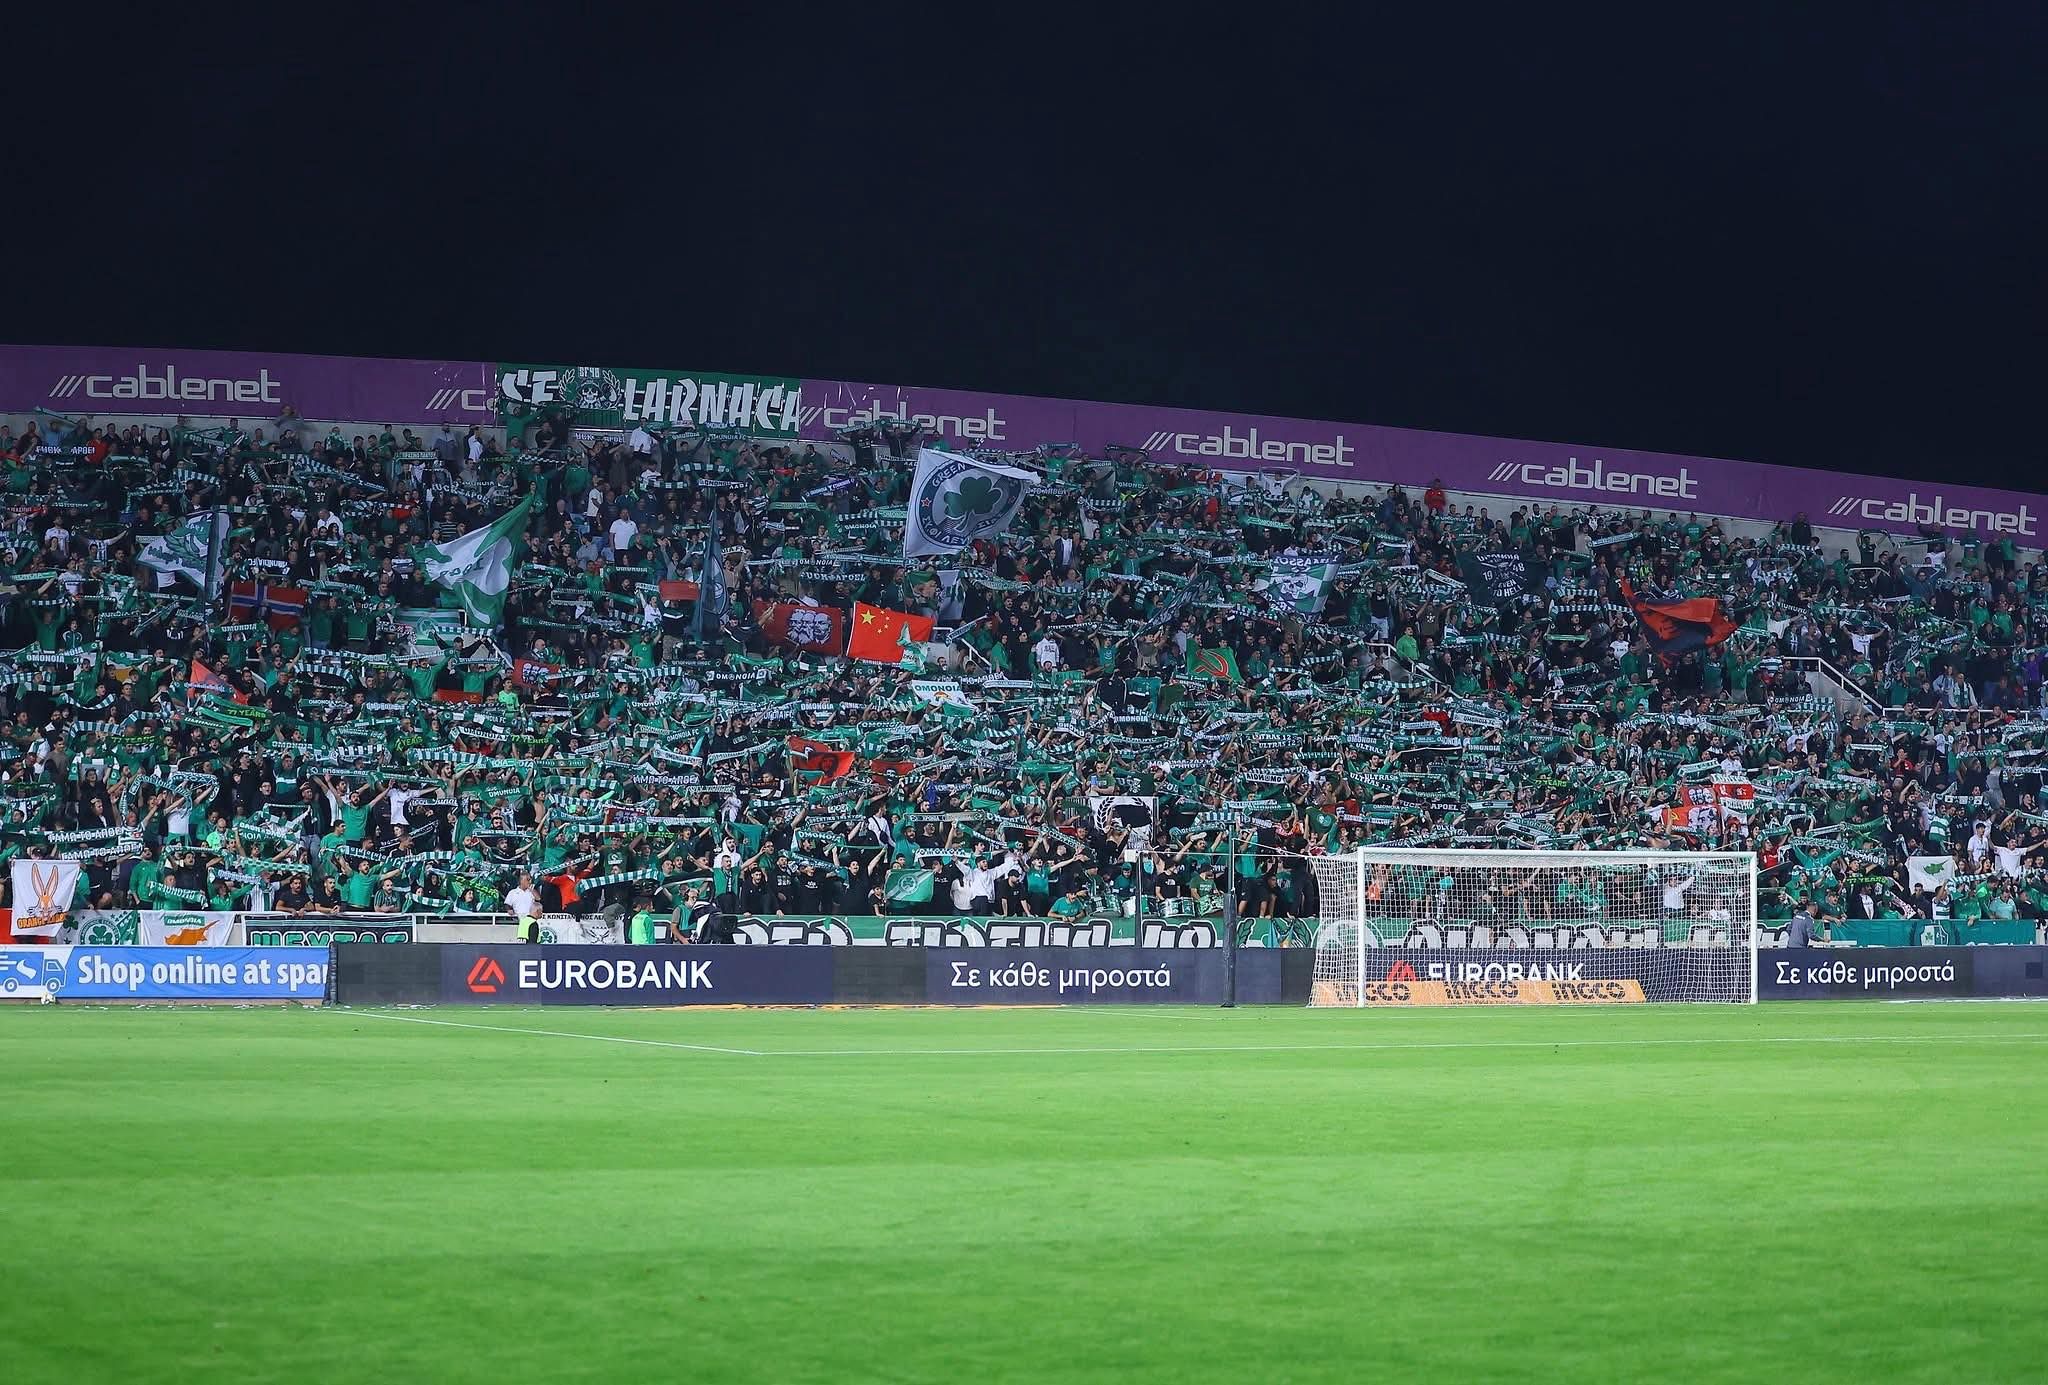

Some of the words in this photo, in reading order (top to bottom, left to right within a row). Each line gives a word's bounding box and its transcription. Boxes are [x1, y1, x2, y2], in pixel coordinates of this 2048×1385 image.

[86, 364, 281, 403] cablenet
[624, 378, 800, 432] LARNACA
[823, 389, 1006, 441] cablenet
[1175, 426, 1355, 466] cablenet
[932, 462, 967, 488] GREEN
[1521, 457, 1698, 499] cablenet
[1861, 493, 2037, 536] cablenet
[1504, 583, 1524, 596] HELL
[221, 624, 257, 633] OMONOIA
[26, 654, 64, 663] OMONOIA
[914, 684, 961, 692] OMONOIA
[581, 691, 600, 700] YEARS
[801, 703, 834, 711] OMONOIA
[238, 709, 267, 719] YEARS
[122, 735, 155, 744] YEARS
[511, 735, 520, 743] 77
[522, 735, 549, 745] YEARS
[666, 731, 692, 742] OMONOIA
[272, 741, 312, 750] OMONOIA
[1258, 740, 1287, 749] ULTRAS
[1355, 743, 1384, 755] ULTRAS
[1350, 773, 1380, 787] ULTRAS
[1364, 773, 1394, 781] ULTRAS
[488, 787, 520, 797] OMONOIA
[1430, 803, 1459, 811] APOEL
[919, 848, 966, 856] OMONOIA
[78, 955, 145, 991] Shop
[152, 955, 237, 985] online
[243, 960, 271, 984] at
[518, 959, 713, 989] EUROBANK
[951, 961, 980, 987] Σε
[988, 961, 1051, 987] κάθε
[1059, 963, 1171, 993] μπροστά
[1427, 963, 1583, 981] EUROBANK
[1775, 961, 1801, 984] Σε
[1807, 960, 1858, 984] κάθε
[1864, 960, 1955, 989] μπροστά
